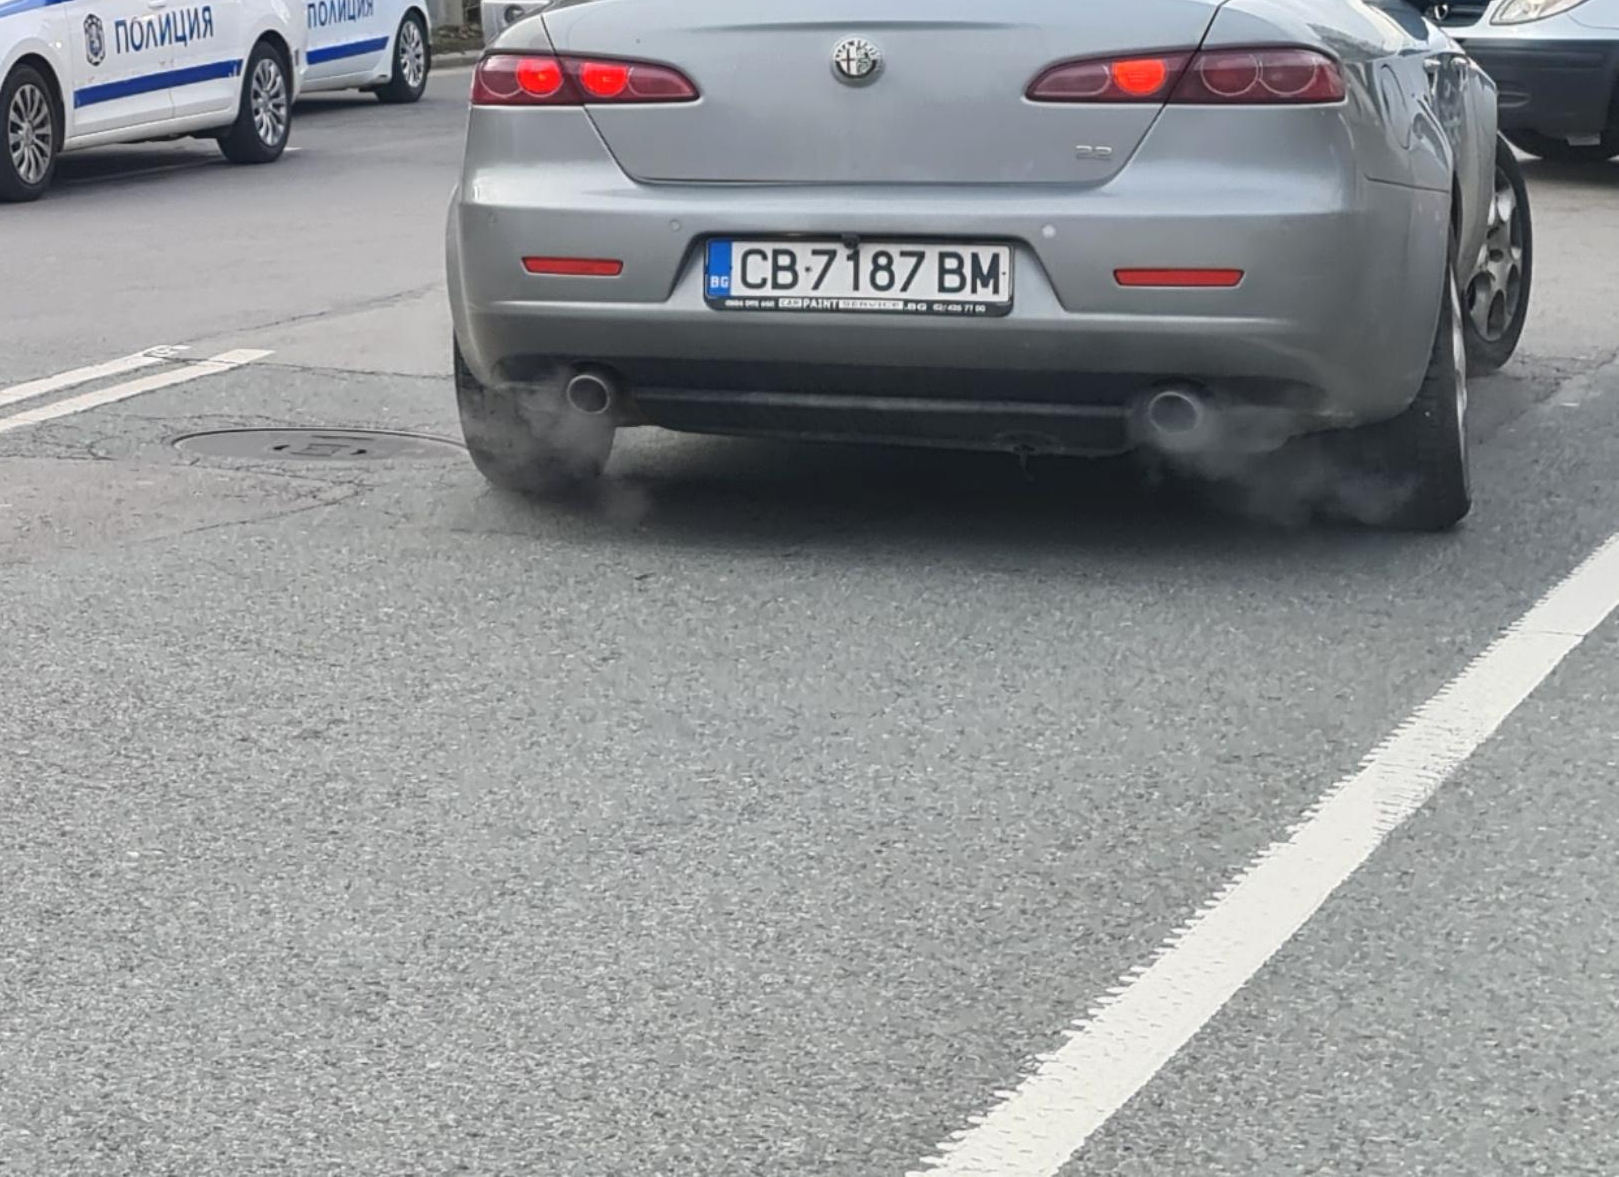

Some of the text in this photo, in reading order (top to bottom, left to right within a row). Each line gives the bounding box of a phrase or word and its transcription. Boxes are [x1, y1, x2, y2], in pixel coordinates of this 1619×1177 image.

[114, 5, 214, 54] ПОЛИЦИЯ
[710, 276, 729, 289] BG
[740, 248, 1000, 296] CB 7187 BM
